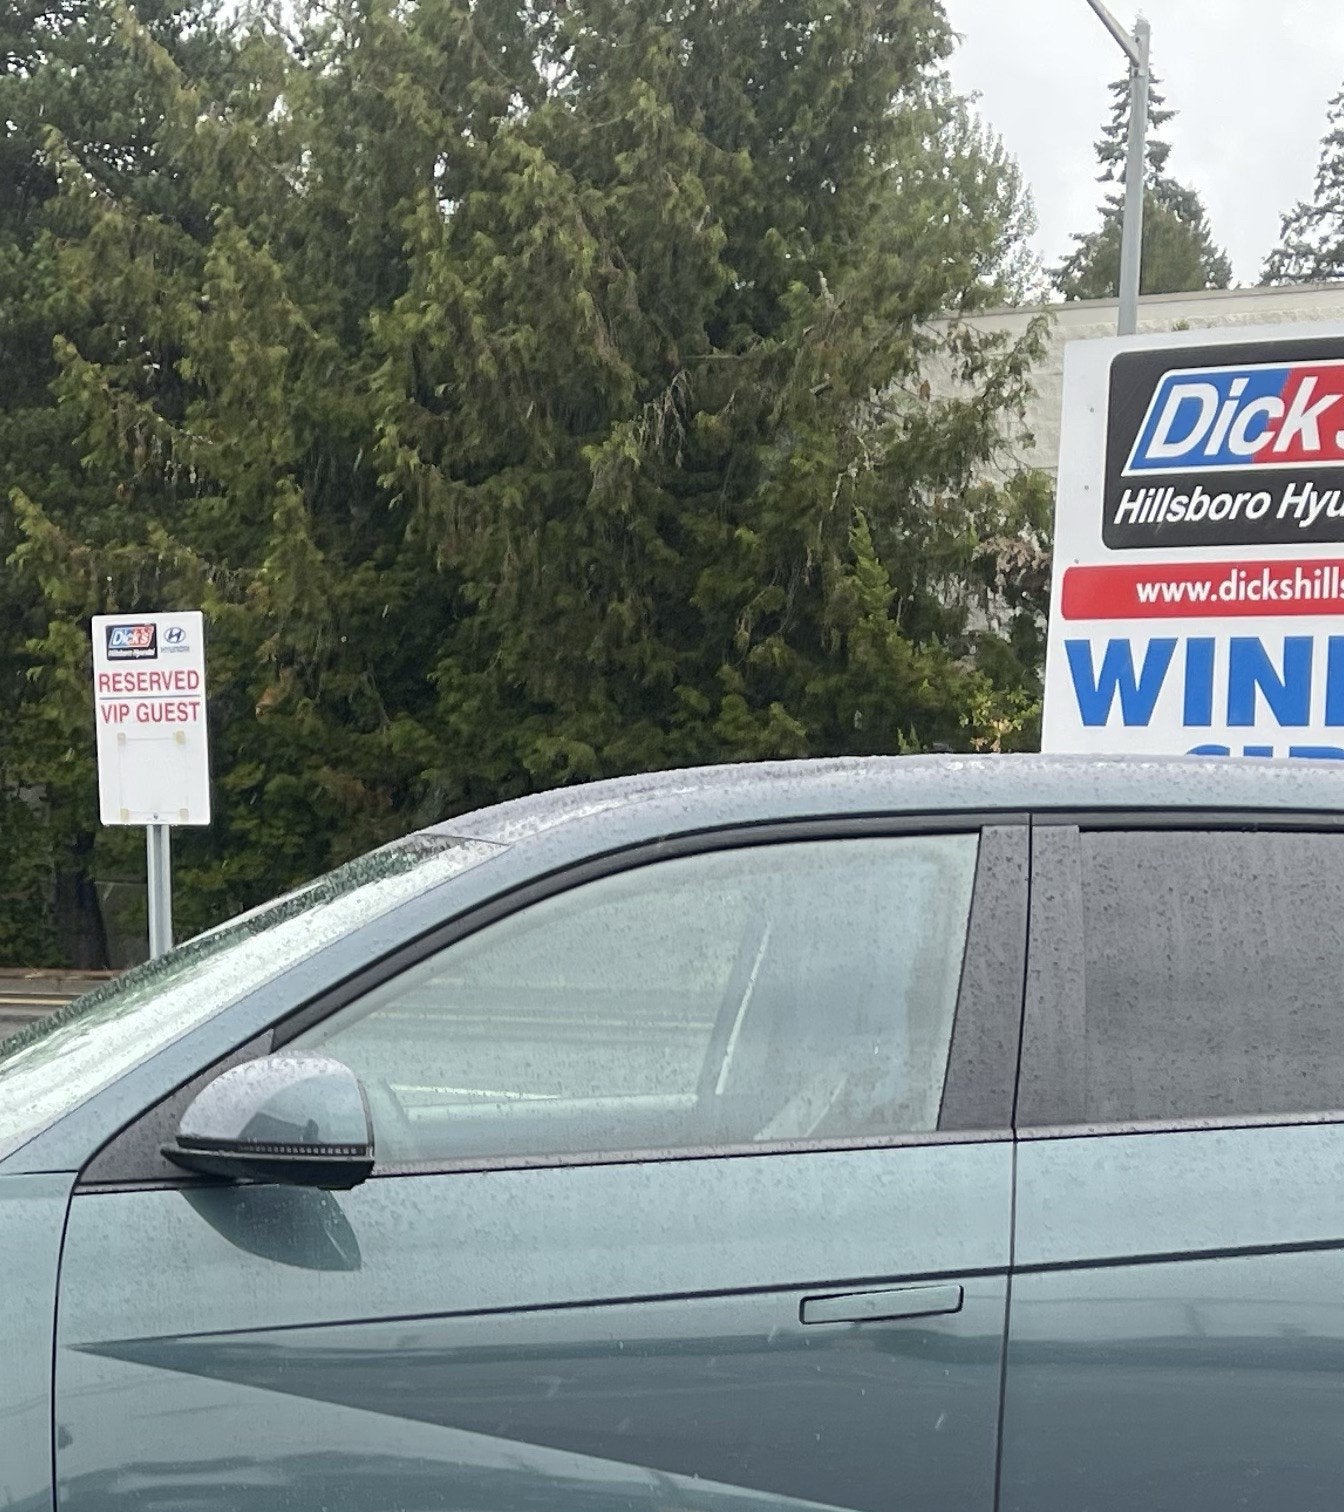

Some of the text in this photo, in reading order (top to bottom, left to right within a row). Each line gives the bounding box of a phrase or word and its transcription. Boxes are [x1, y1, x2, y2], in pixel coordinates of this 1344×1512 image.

[1113, 486, 1272, 525] Hillsboro
[98, 670, 200, 692] RESERVED
[101, 701, 201, 724] VIP GUEST
